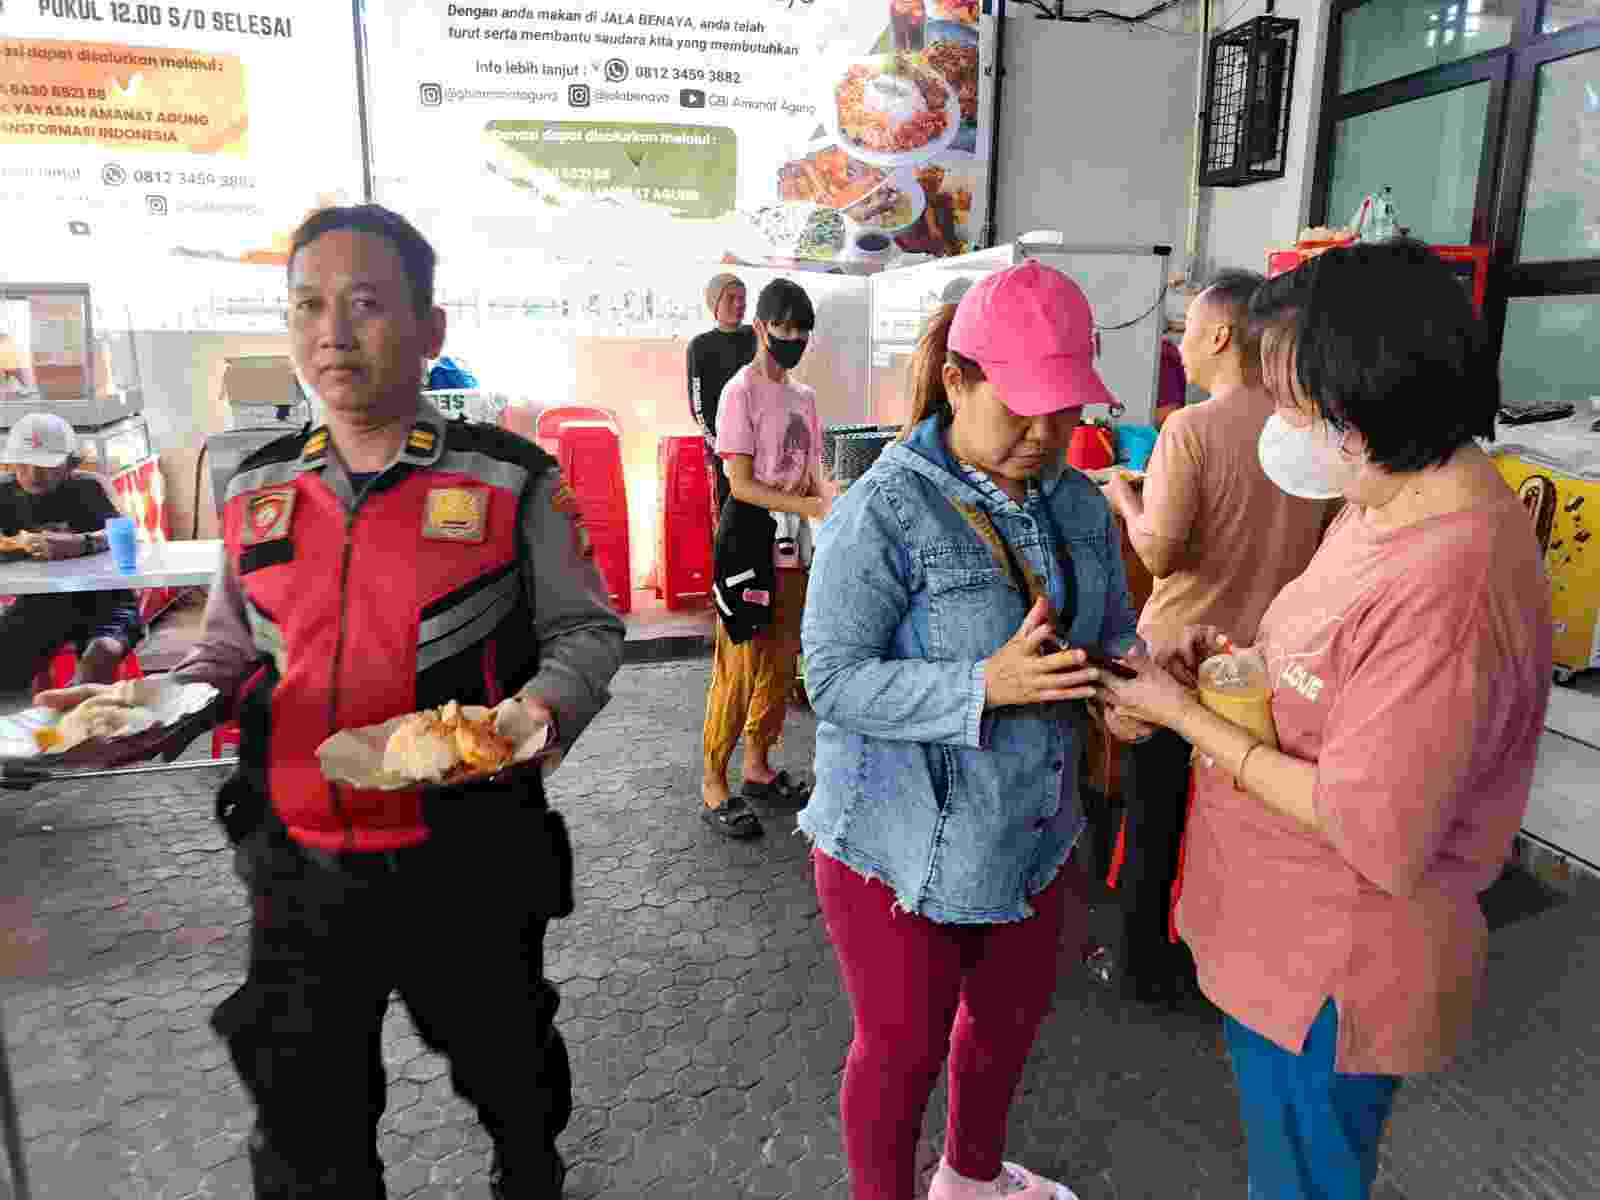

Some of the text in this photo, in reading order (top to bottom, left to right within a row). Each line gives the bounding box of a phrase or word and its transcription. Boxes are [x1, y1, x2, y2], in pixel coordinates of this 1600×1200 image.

[38, 0, 104, 21] PUKUL
[110, 0, 161, 25] 12.00
[211, 11, 293, 38] SELESAI
[447, 4, 766, 33] Dengan anda makan di JALA BENAYA, anda telah
[448, 26, 800, 56] turut serta membantu saudara kita yang membutuhkan
[475, 59, 502, 74] Info
[505, 60, 538, 74] lebih
[542, 63, 579, 80] lanjut
[635, 66, 669, 79] 0812
[672, 68, 704, 80] 3459
[709, 70, 742, 84] 3882
[14, 103, 209, 127] YAYASAN AMANAT AGUNG
[98, 127, 178, 142] INDONESIA
